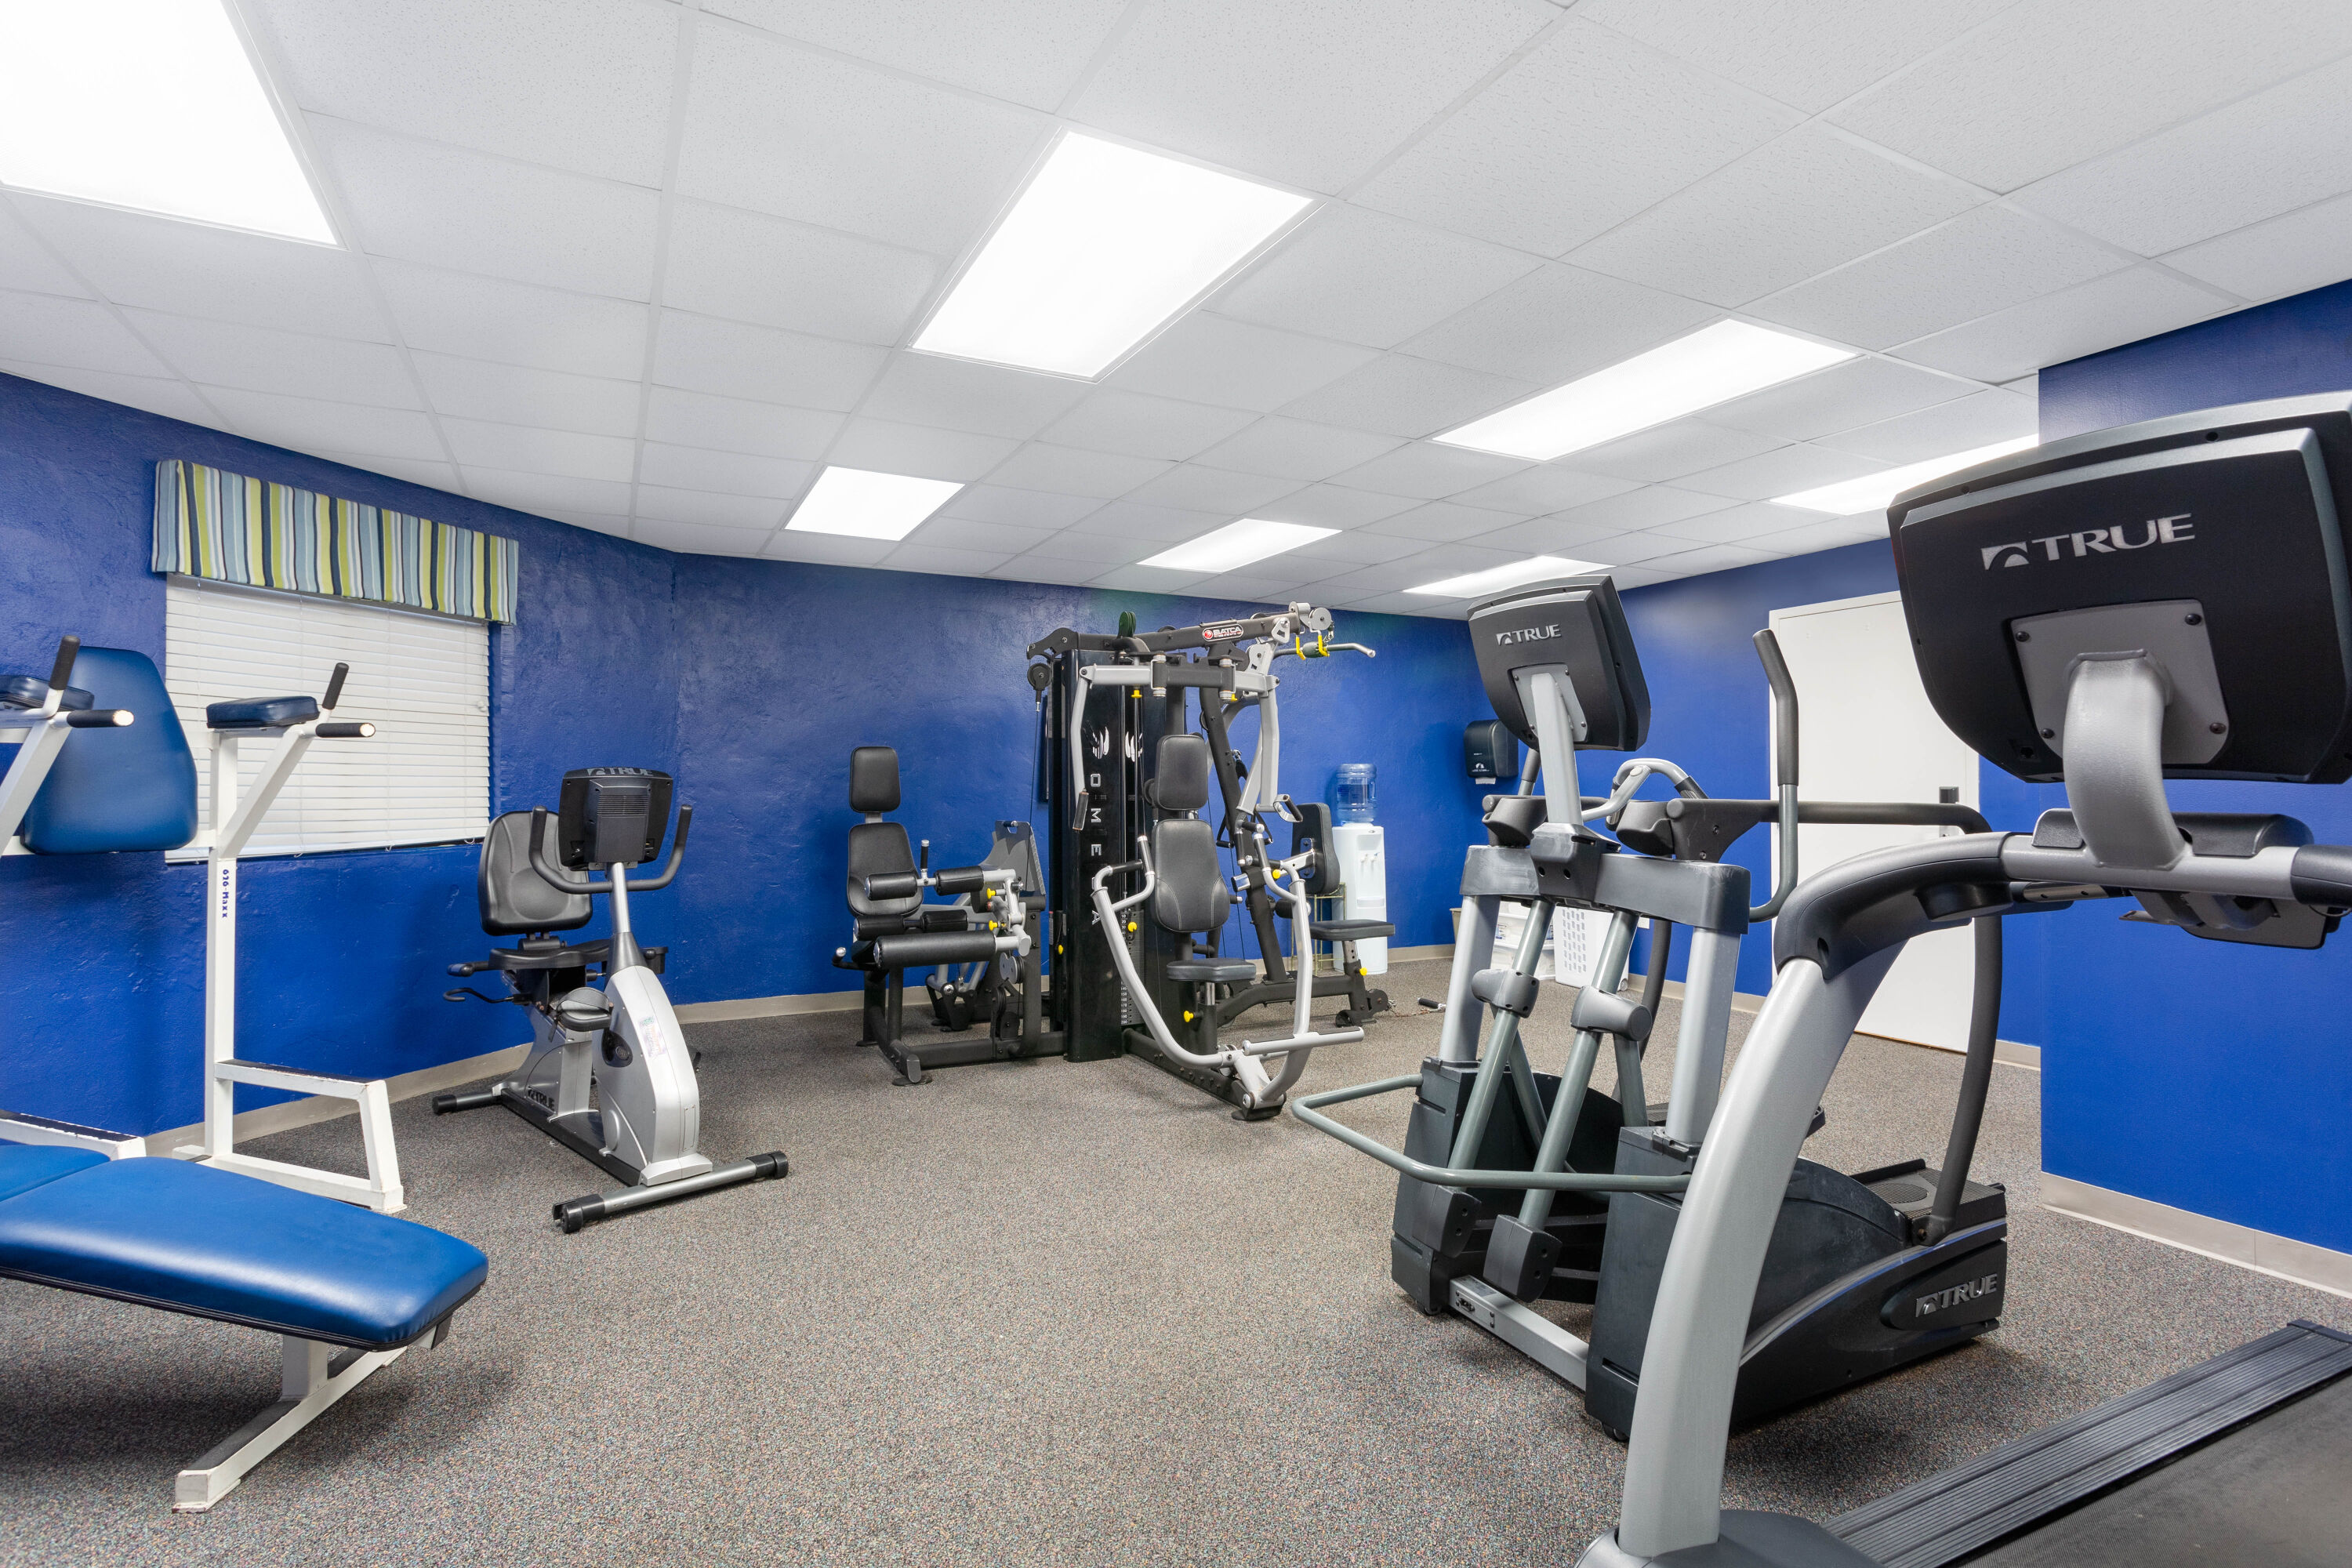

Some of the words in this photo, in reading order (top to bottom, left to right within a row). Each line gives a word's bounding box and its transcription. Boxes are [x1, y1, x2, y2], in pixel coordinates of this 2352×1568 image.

[2031, 513, 2195, 561] TRUE
[1213, 626, 1242, 635] BATCA
[1512, 624, 1562, 643] TRUE
[605, 768, 654, 776] TRUE
[1091, 773, 1102, 925] OMEA
[1938, 1273, 1998, 1308] TRUE
